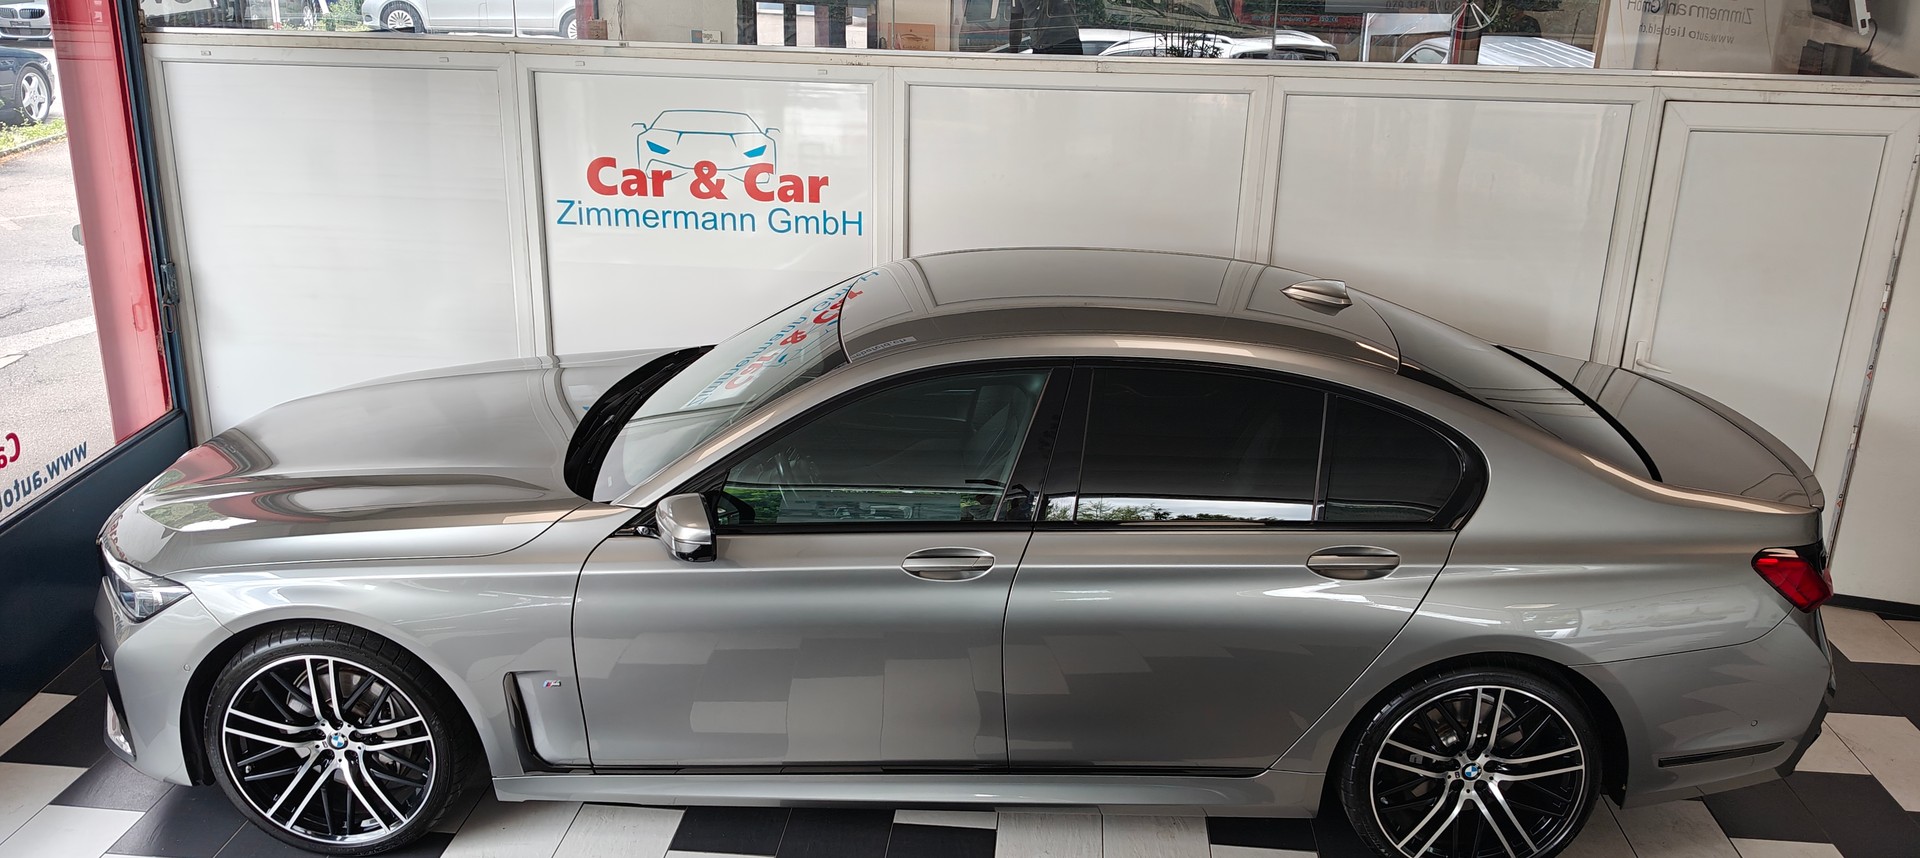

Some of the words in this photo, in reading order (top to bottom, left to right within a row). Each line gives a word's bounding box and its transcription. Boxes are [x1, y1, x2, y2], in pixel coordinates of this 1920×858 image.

[586, 156, 672, 197] Car
[690, 160, 728, 200] &
[744, 162, 829, 204] Car
[556, 199, 755, 232] Zimmermann
[768, 207, 863, 236] GmbH
